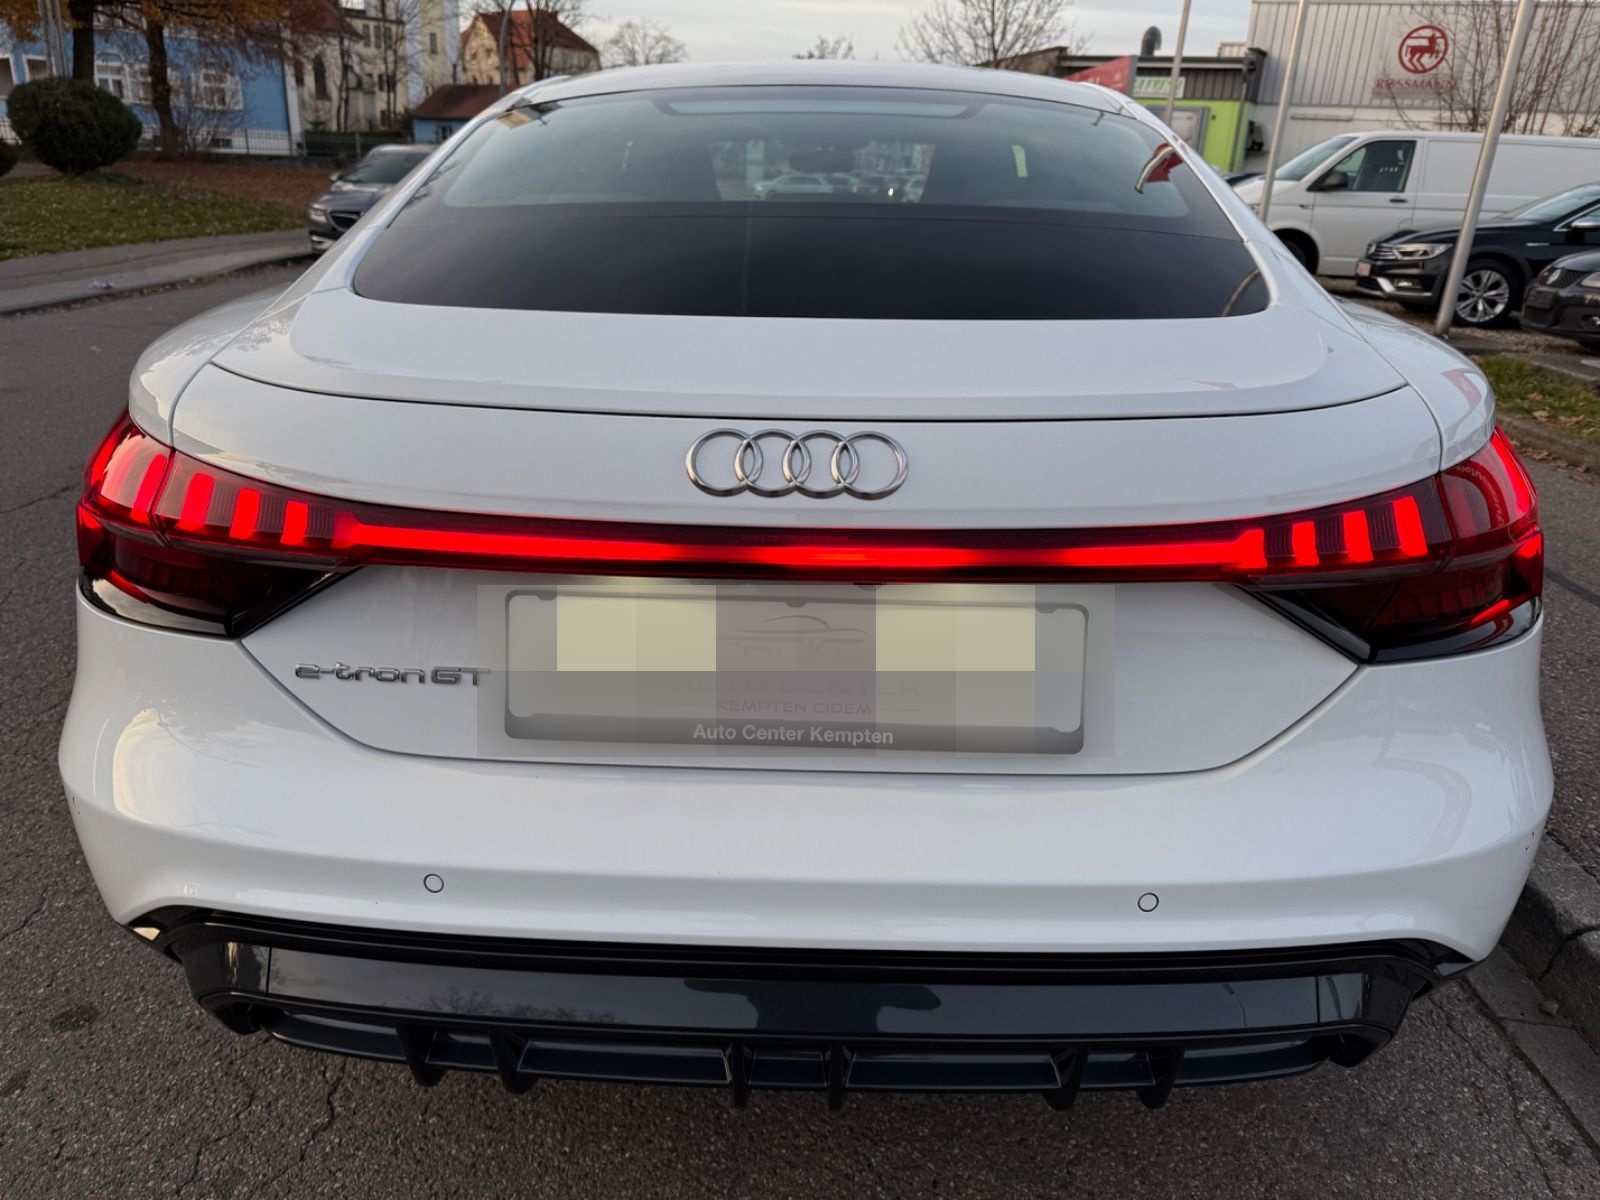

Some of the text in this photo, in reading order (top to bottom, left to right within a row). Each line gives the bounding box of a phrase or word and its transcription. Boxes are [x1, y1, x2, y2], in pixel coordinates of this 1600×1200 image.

[716, 699, 873, 715] KEMPTEN CIDEM
[692, 723, 894, 746] Auto Center Kempten
